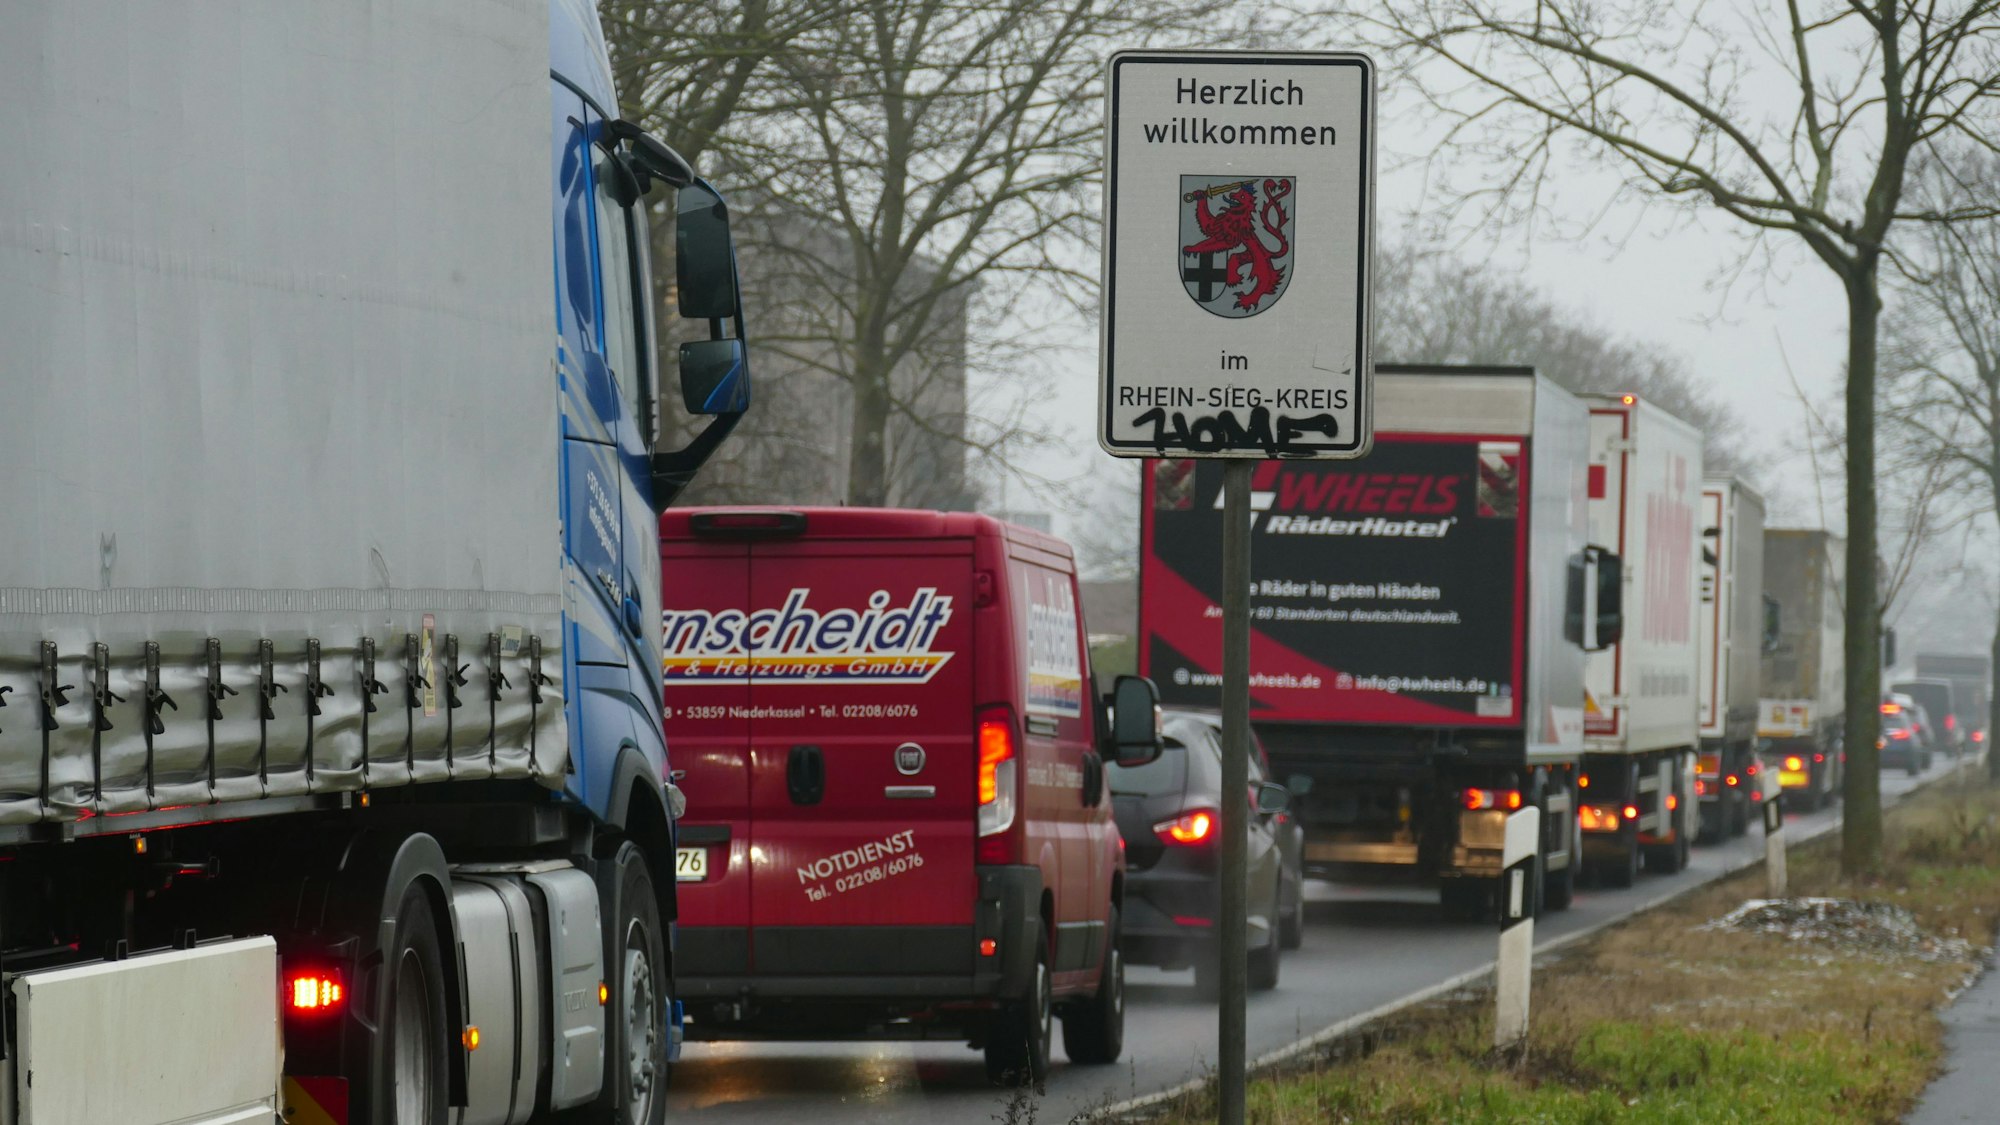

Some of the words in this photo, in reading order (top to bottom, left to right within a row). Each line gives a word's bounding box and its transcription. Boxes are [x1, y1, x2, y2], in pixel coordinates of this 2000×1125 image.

[1177, 78, 1303, 105] Herzlich
[1144, 117, 1336, 145] willkommen
[1221, 350, 1248, 370] im
[1119, 386, 1348, 409] RHEIN-SIEG-KREIS
[1261, 580, 1310, 597] Räder
[1310, 580, 1327, 597] in
[1328, 582, 1376, 602] guten
[1378, 582, 1441, 600] Händen
[685, 660, 701, 676] &
[713, 660, 834, 679] Heizungs
[848, 659, 928, 676] GmbH
[1355, 674, 1487, 693] info@4wheels.de
[687, 706, 726, 719] 53859
[729, 705, 805, 719] Niederkassel
[819, 704, 839, 718] Tel.
[843, 704, 918, 719] 02208/6076
[678, 852, 702, 872] 76
[797, 829, 914, 885] NOTDIENST
[805, 884, 832, 902] Tel.
[835, 853, 924, 893] 02208/6076
